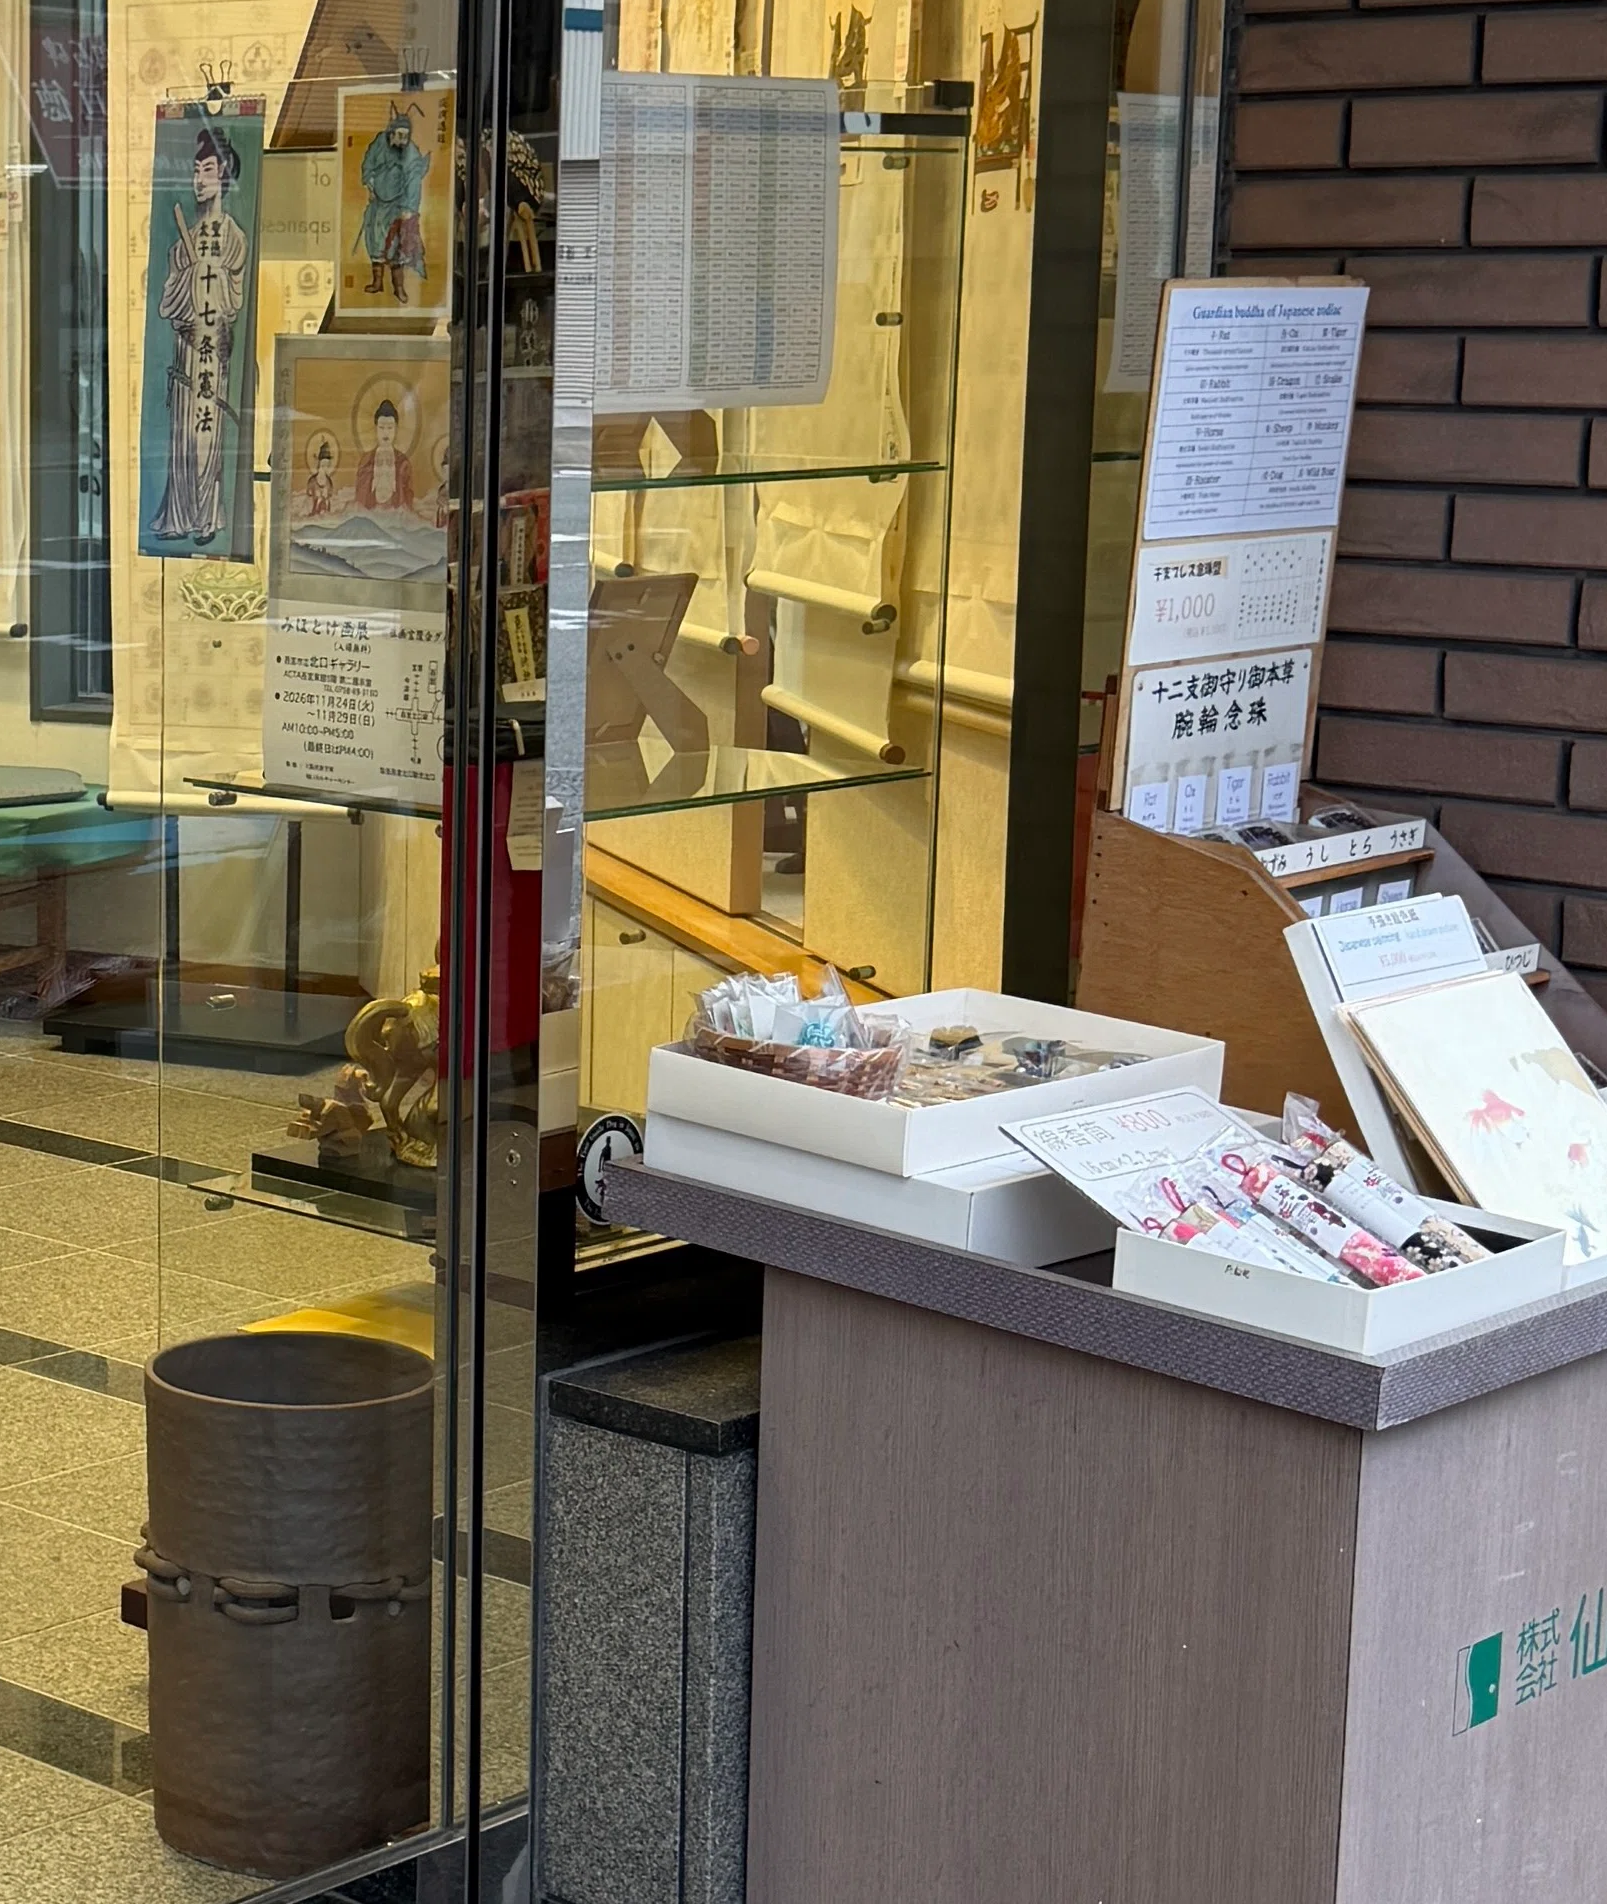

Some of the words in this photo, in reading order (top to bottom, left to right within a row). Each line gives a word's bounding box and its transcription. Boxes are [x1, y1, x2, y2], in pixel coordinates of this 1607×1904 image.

[1193, 305, 1232, 320] Guardian
[1235, 303, 1265, 318] buddha
[1278, 303, 1315, 322] Japanese
[194, 264, 217, 434] 十七条憲法
[1155, 592, 1216, 624] ¥1,000
[1151, 658, 1296, 704] 十二支御守り御本尊
[1171, 696, 1268, 741] 腕輪念珠
[1226, 775, 1245, 793] Tiger
[1306, 844, 1329, 867] うし
[1349, 835, 1372, 857] とら
[1388, 825, 1418, 850] うさぎ
[1504, 950, 1533, 971] ひつじ
[1115, 1107, 1173, 1135] ¥800
[1516, 1607, 1561, 1665] 株式
[1515, 1656, 1558, 1706] 会社
